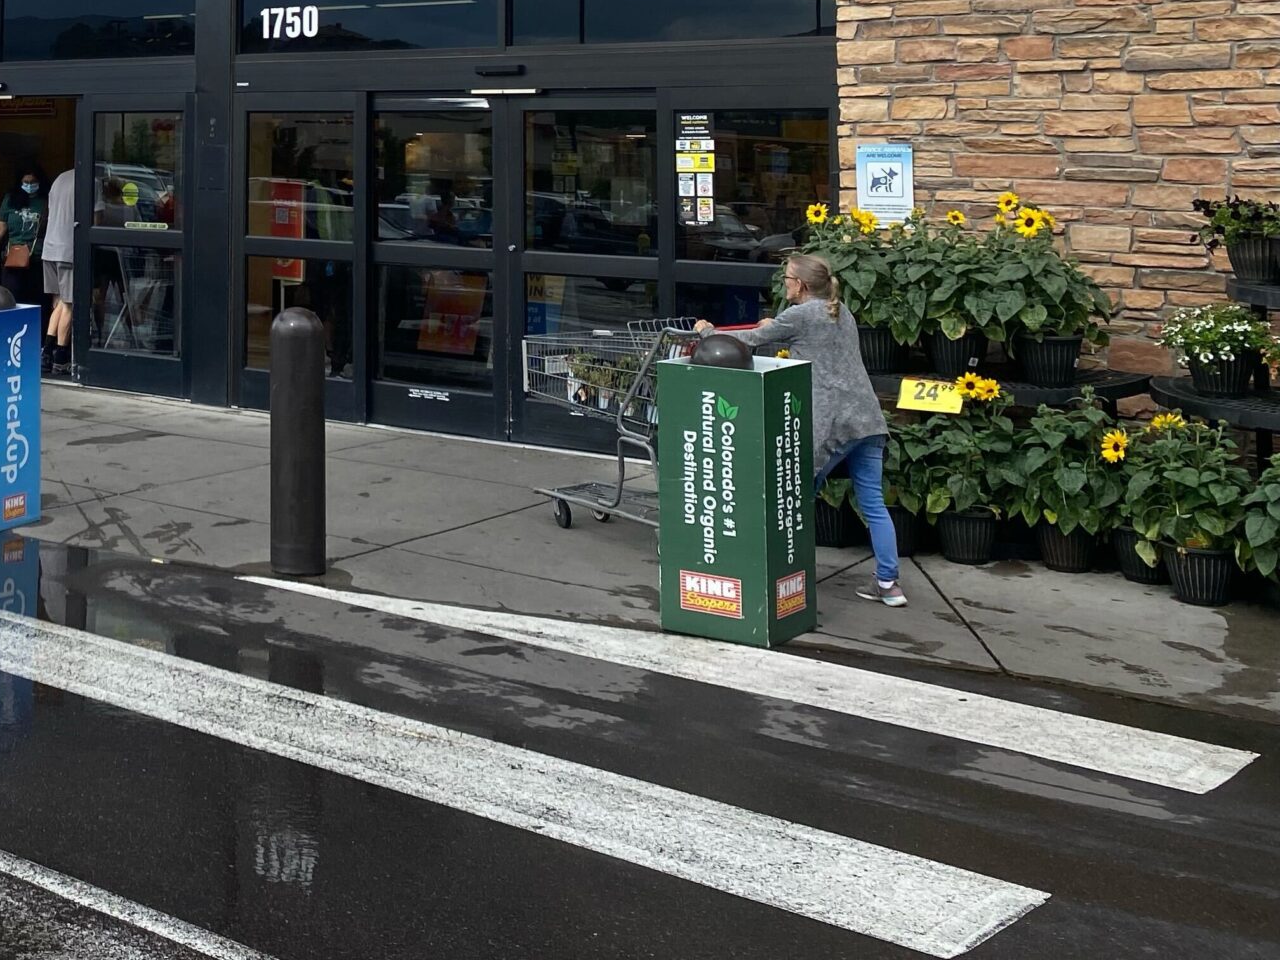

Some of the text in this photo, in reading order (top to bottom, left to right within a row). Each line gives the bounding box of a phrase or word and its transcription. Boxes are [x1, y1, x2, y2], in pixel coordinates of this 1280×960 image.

[260, 5, 319, 39] 1750
[5, 496, 24, 510] KING
[683, 430, 698, 525] Destination
[700, 391, 717, 565] Natural and Organic
[721, 421, 737, 537] Colorado's #1
[775, 435, 784, 531] Destination
[783, 391, 794, 565] Natural and Organic
[793, 417, 803, 531] Colorado's #1
[685, 575, 736, 599] KING
[685, 592, 737, 612] Soopers
[779, 575, 803, 599] KING
